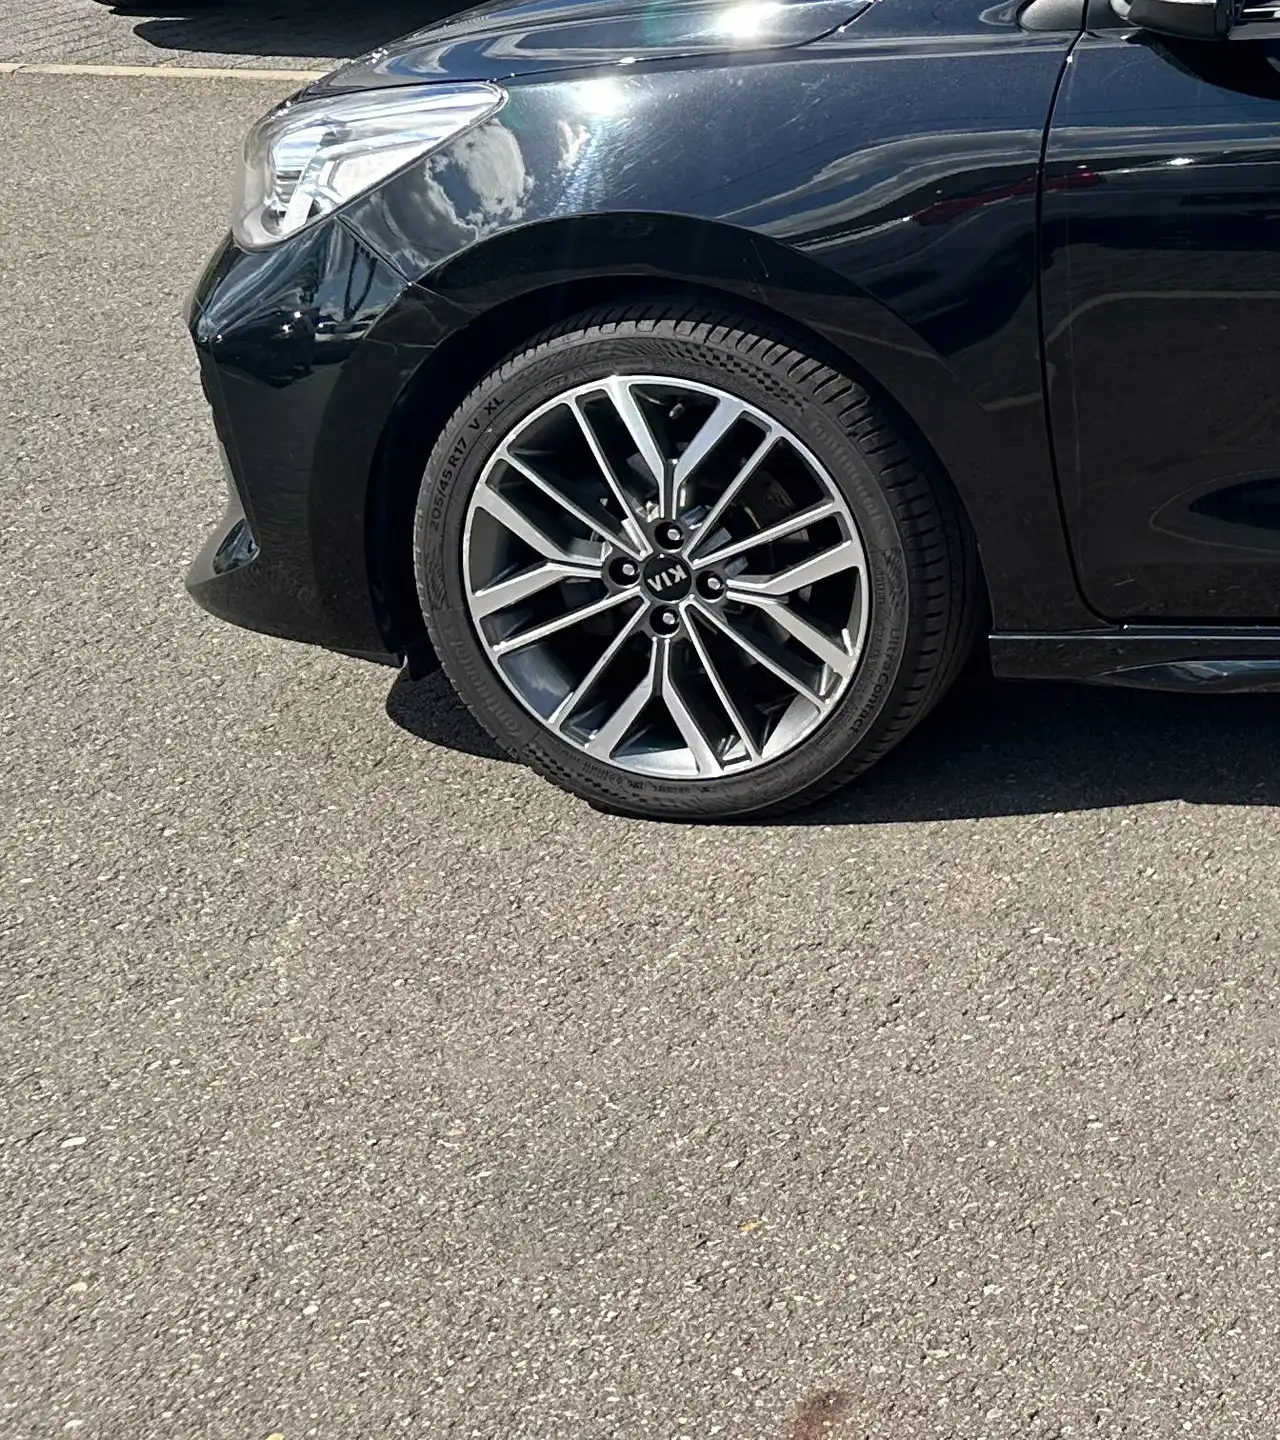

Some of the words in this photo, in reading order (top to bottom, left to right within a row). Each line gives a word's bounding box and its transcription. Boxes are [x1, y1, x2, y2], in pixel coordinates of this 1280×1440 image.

[447, 437, 468, 470] R17
[483, 396, 505, 416] XL
[647, 564, 687, 591] KIA
